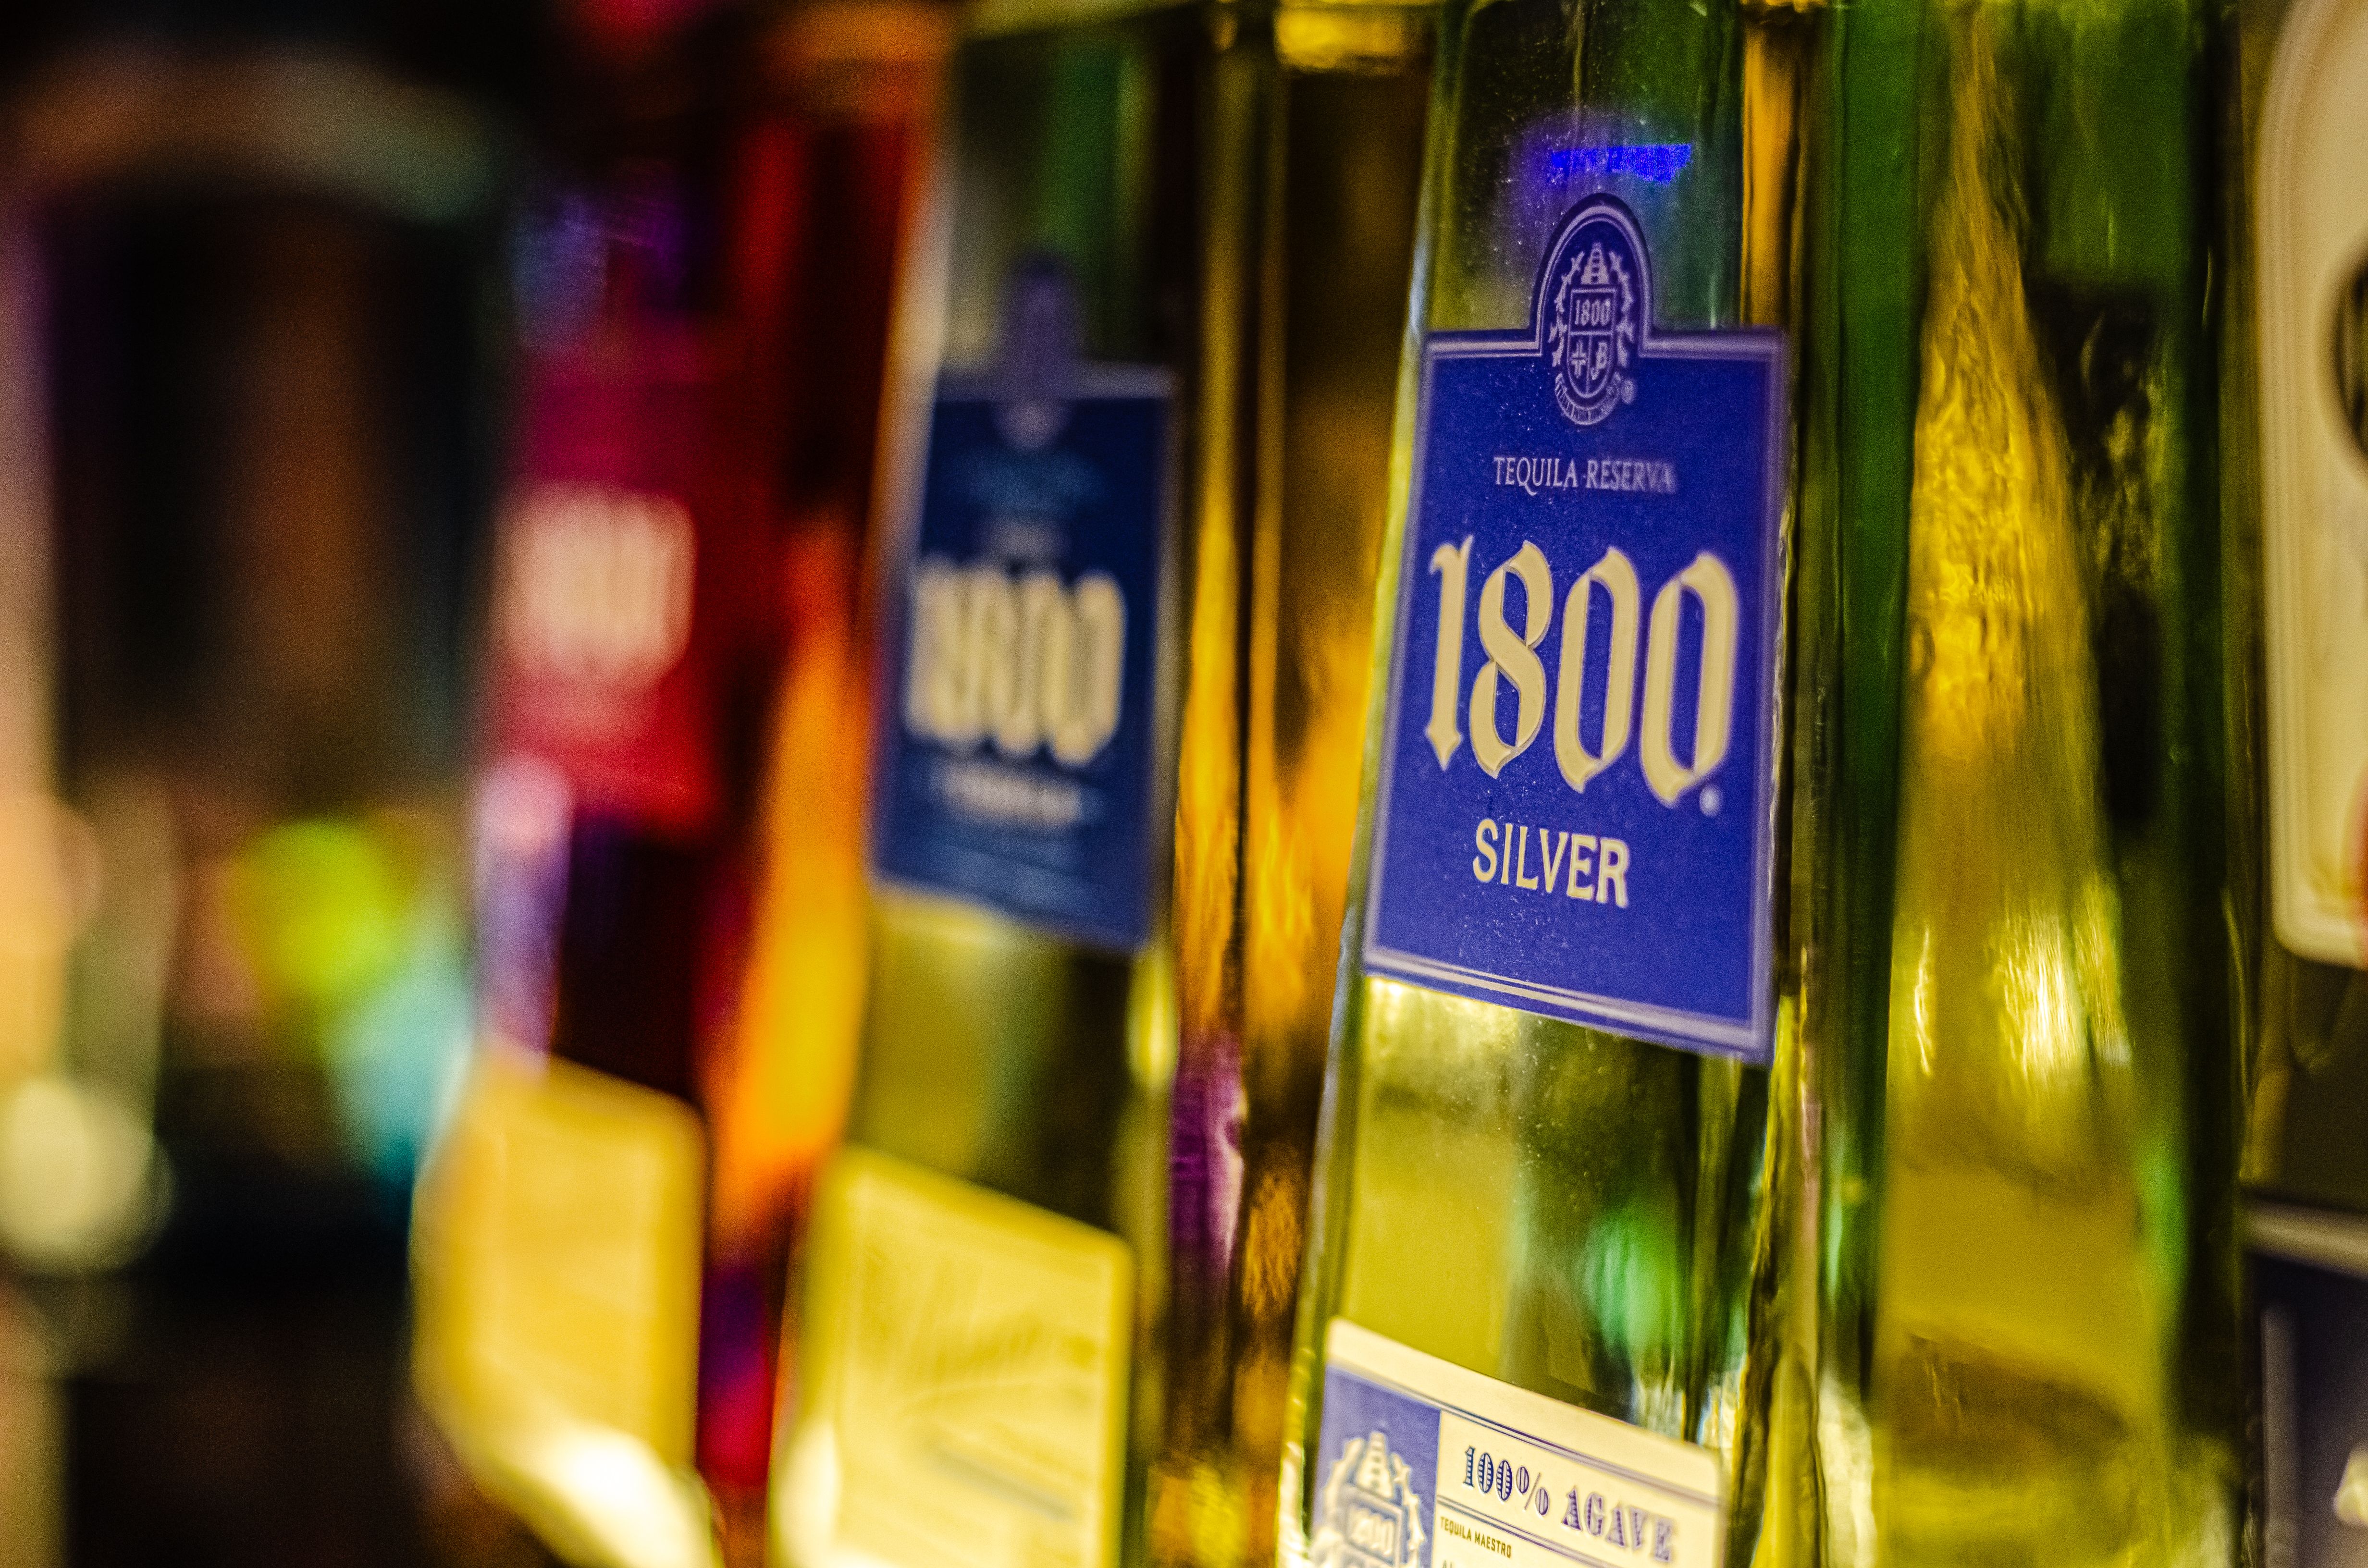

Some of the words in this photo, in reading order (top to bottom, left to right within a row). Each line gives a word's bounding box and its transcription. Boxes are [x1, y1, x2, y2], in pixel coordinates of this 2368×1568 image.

[1574, 298, 1611, 327] 1800
[1493, 457, 1578, 496] TEQUILA
[1586, 459, 1676, 495] RESERVA
[1425, 534, 1739, 809] 1800
[1473, 818, 1630, 908] SILVER
[1462, 1445, 1550, 1516] 100%
[1561, 1486, 1673, 1562] AGAVE
[1441, 1516, 1471, 1542] TEQUILA
[1475, 1531, 1512, 1559] MAESTRO
